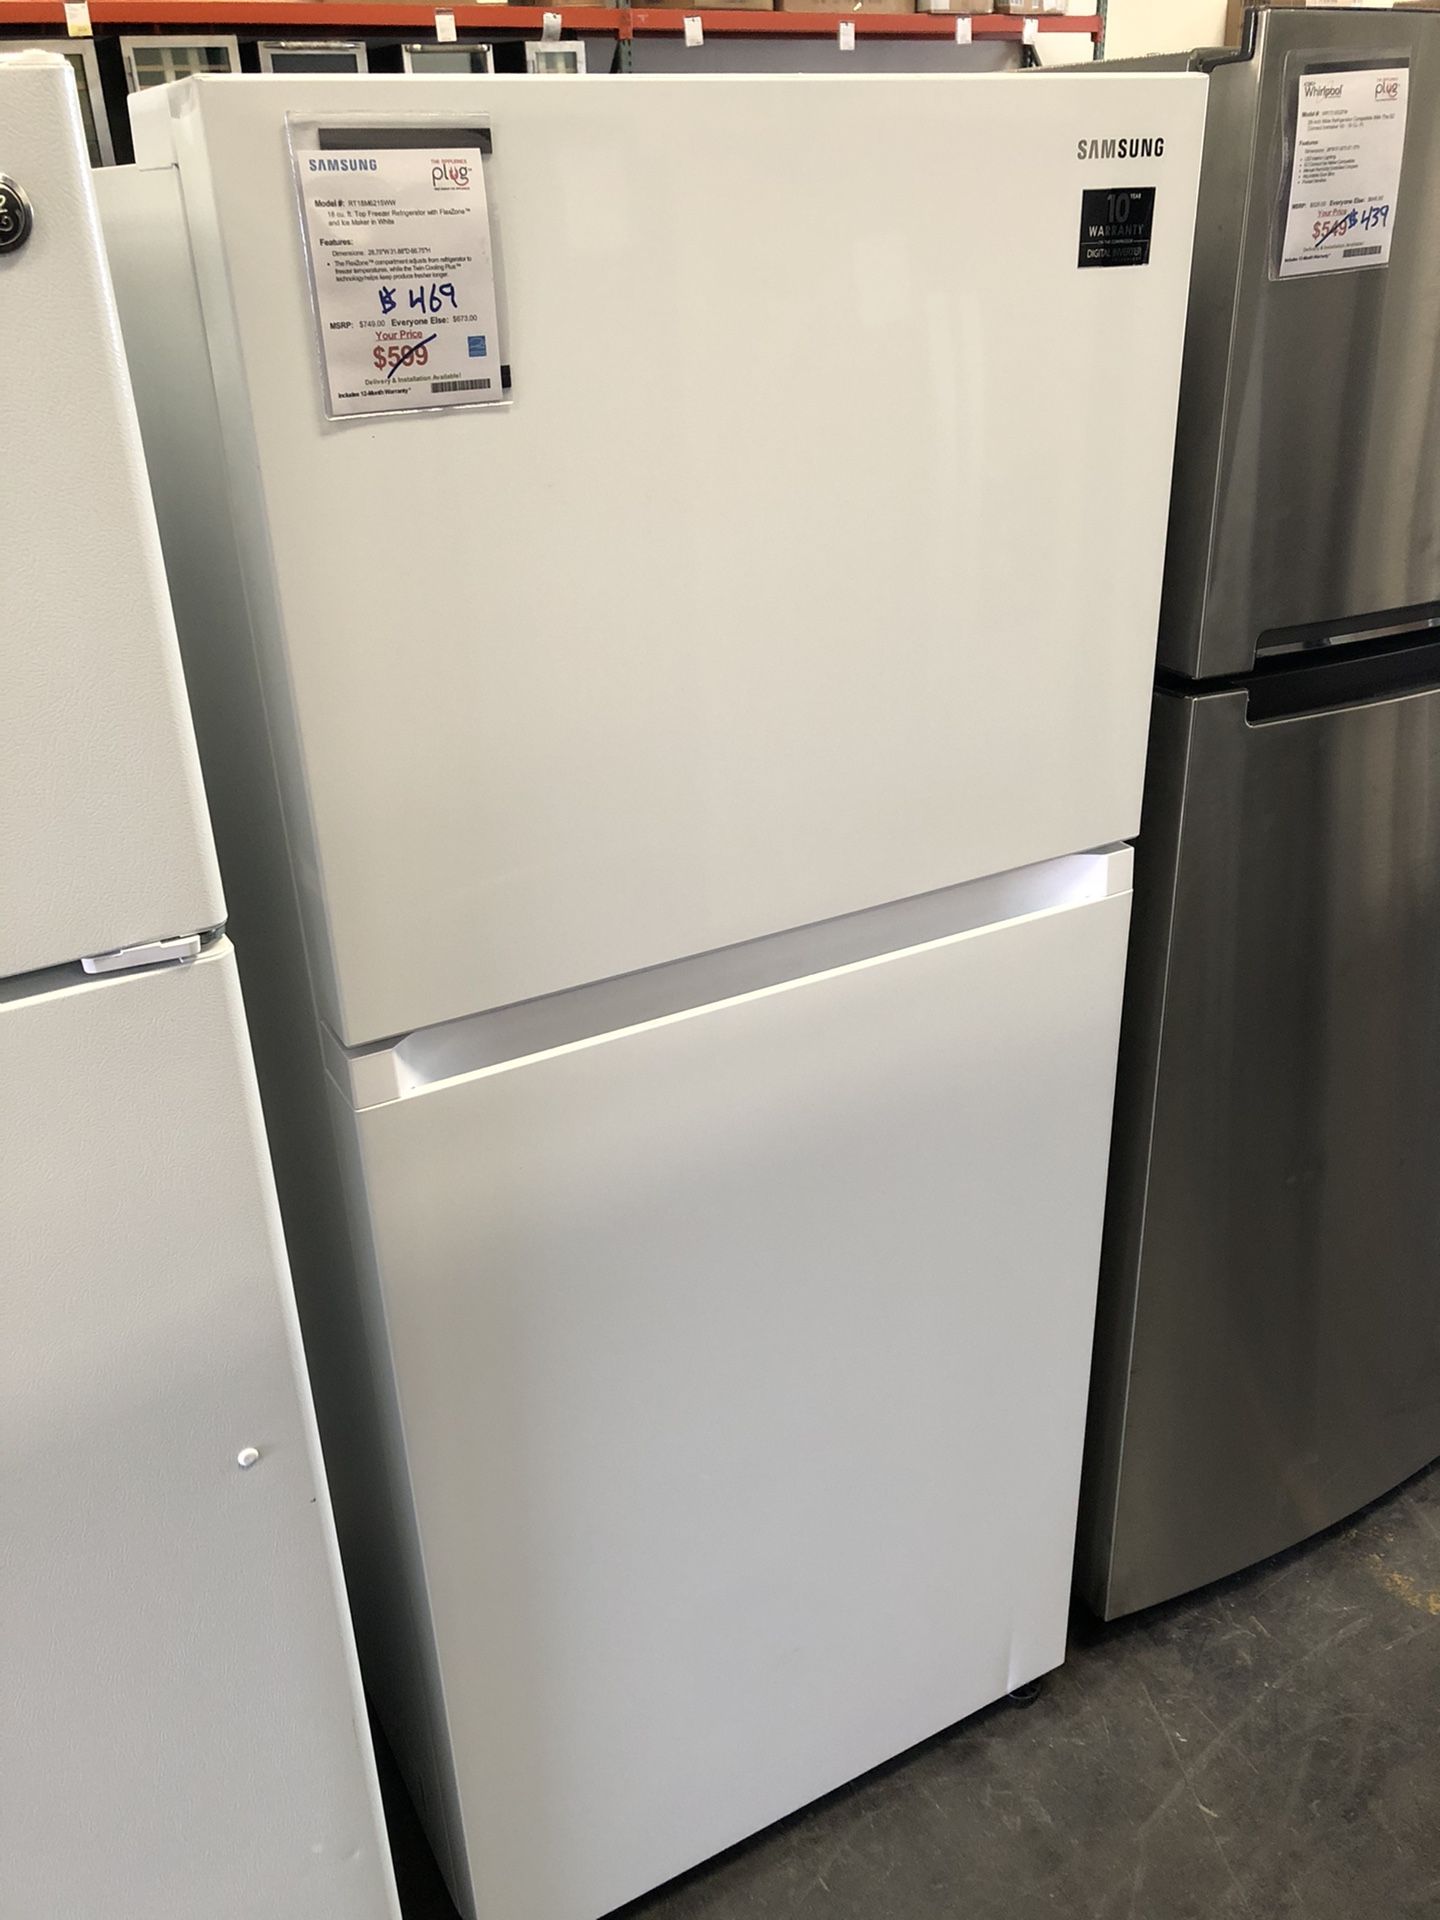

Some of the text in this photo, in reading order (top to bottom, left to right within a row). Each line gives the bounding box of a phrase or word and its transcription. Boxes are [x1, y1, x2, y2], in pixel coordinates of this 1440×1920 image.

[1304, 83, 1343, 98] Whirlpool
[1077, 137, 1164, 160] SAMSUNG
[308, 158, 377, 171] SAMSUNG
[314, 199, 337, 207] Model
[1107, 193, 1130, 223] 10
[391, 209, 425, 217] Refrigerator
[1088, 223, 1144, 237] WARRANTY
[319, 238, 354, 246] Features:
[1087, 247, 1111, 258] DIGITAL
[409, 282, 458, 314] 469
[330, 320, 354, 329] MSRP:
[391, 318, 428, 327] Everyone
[430, 316, 449, 324] Else:
[375, 329, 423, 340] Your Price
[373, 344, 429, 371] $599
[365, 377, 391, 386] Delivery
[338, 391, 359, 399] Includes
